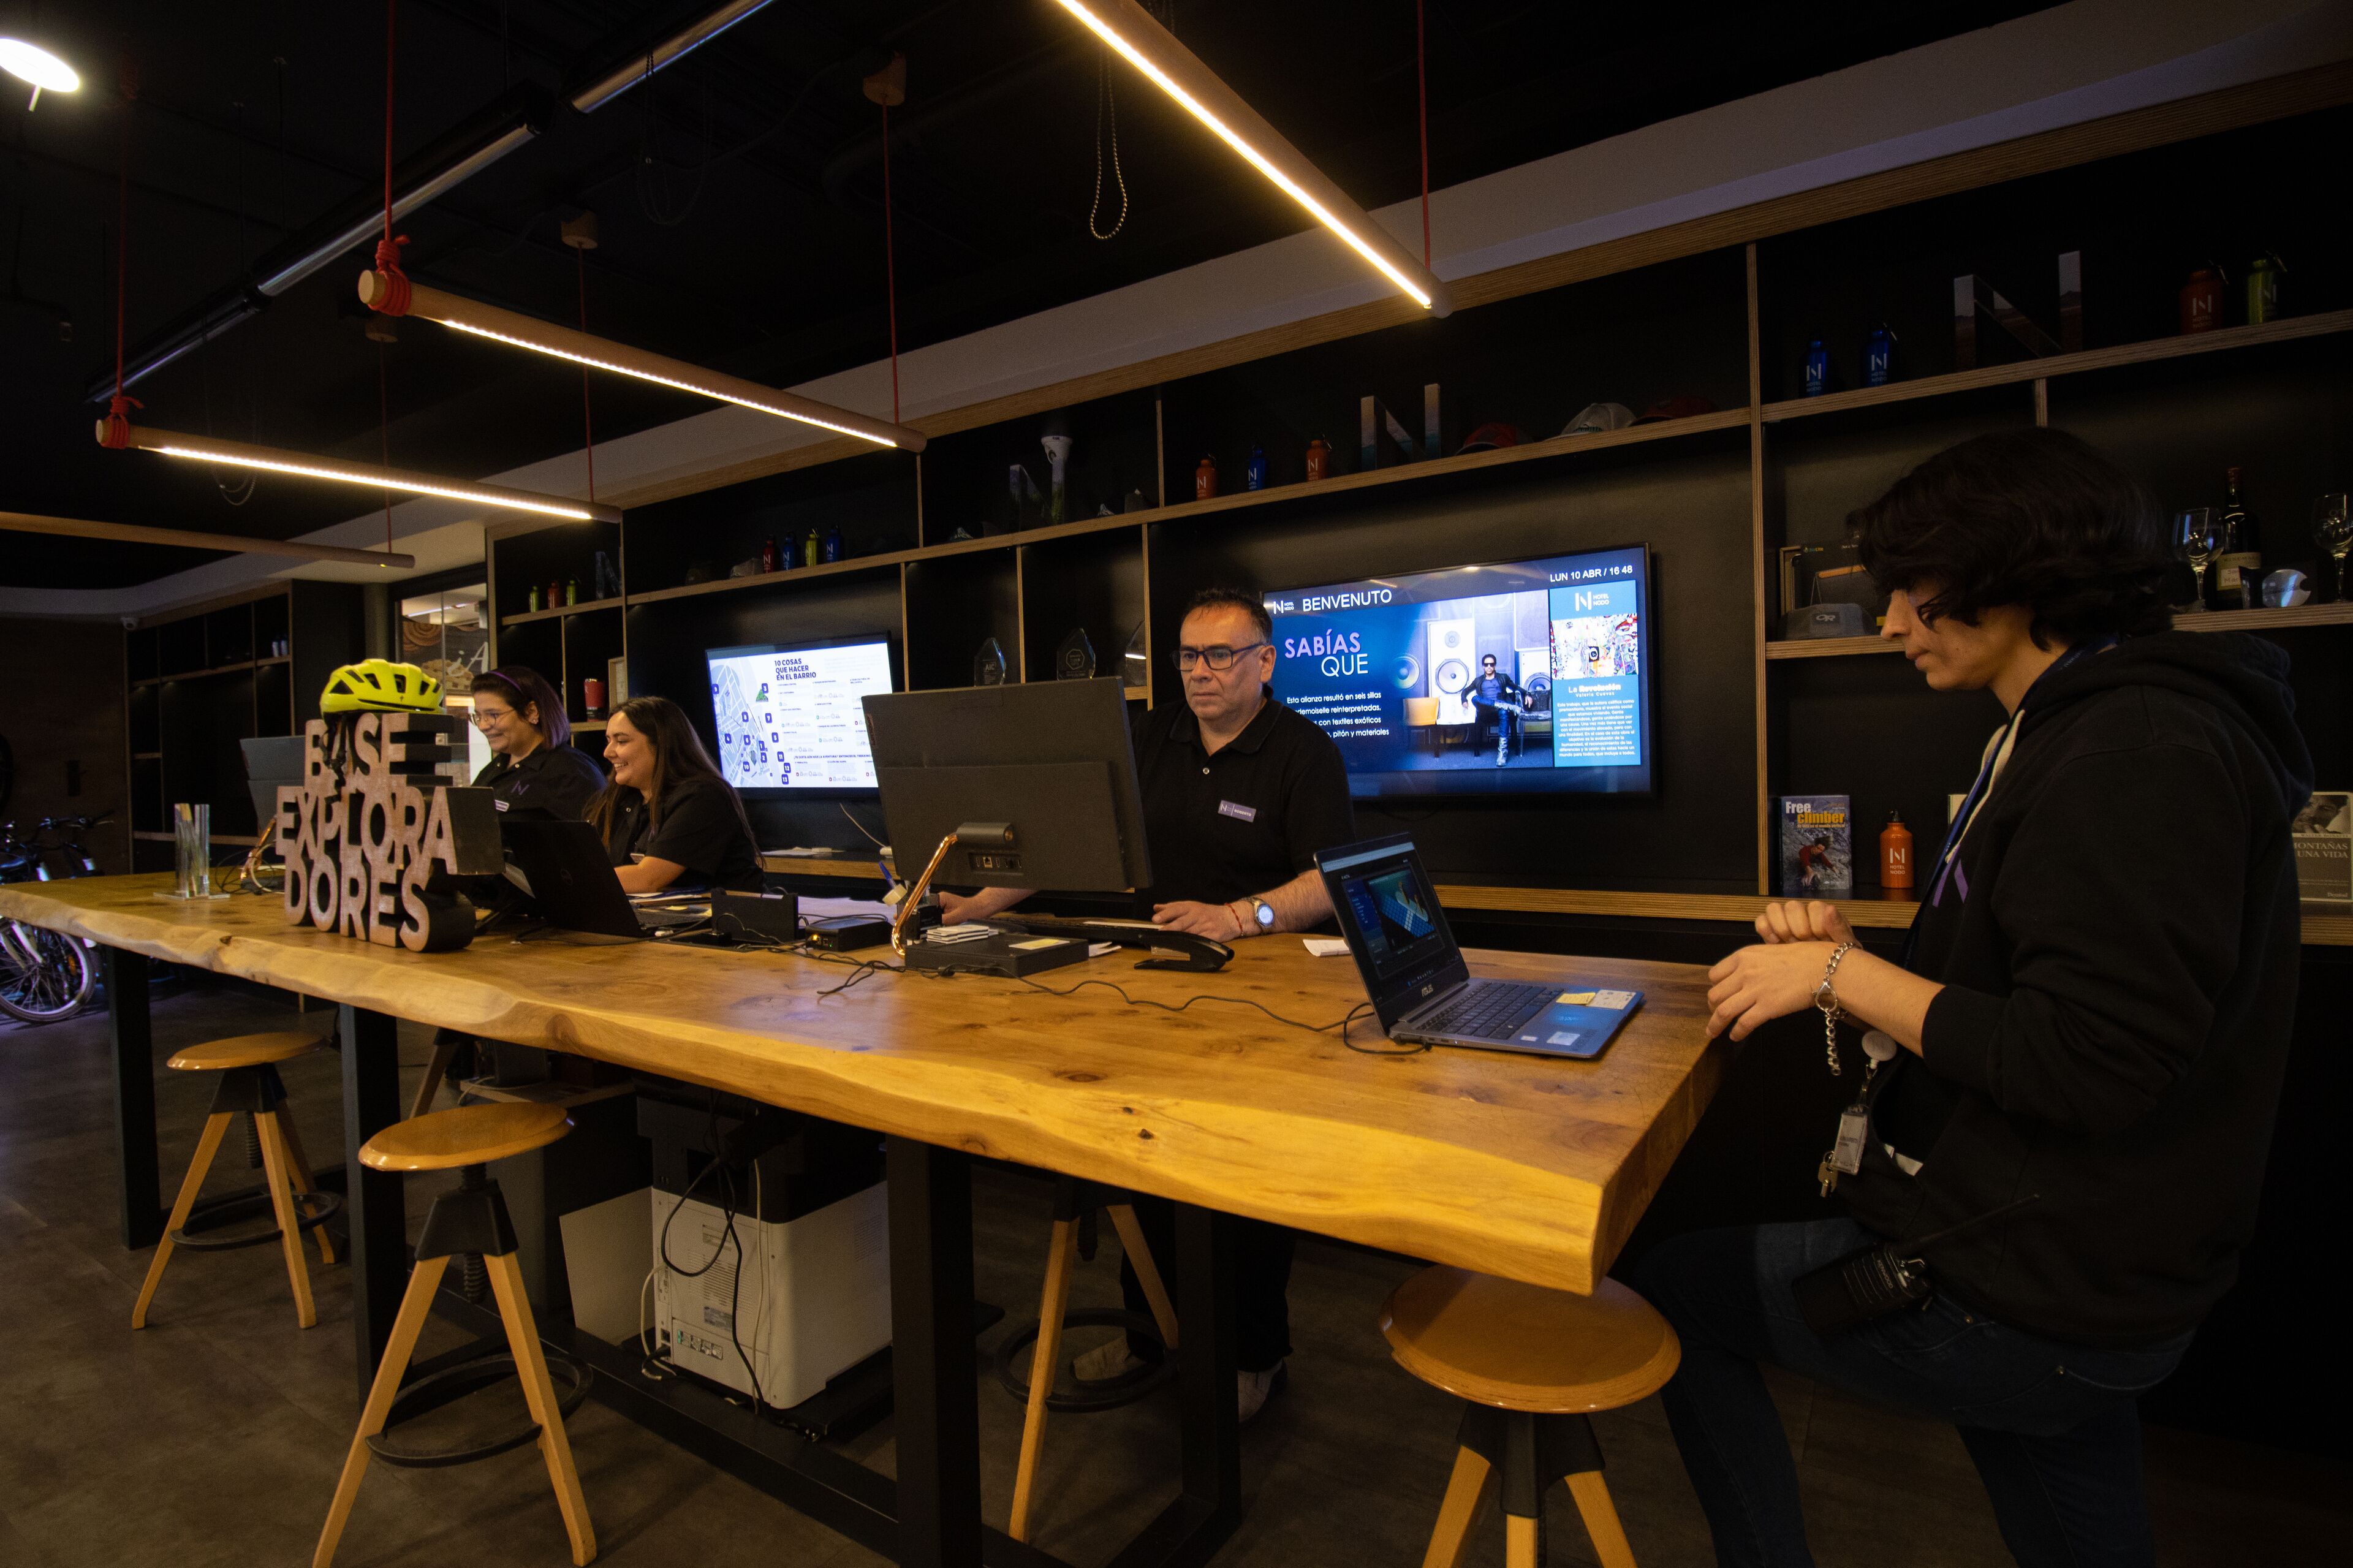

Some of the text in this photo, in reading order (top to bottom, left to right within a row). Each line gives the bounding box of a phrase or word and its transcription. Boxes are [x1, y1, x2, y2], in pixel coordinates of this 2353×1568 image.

[2193, 294, 2212, 316] N
[1871, 353, 1887, 371] N
[1806, 363, 1822, 381] N
[1308, 458, 1318, 472] N
[1248, 467, 1257, 481] N
[1550, 573, 1568, 582] LUN
[1571, 571, 1580, 580] 10
[1582, 569, 1602, 579] ABR
[1273, 600, 1284, 614] N
[1303, 589, 1392, 612] BENVENUTO
[1575, 591, 1592, 611] N
[1284, 629, 1361, 658] SABÍAS
[776, 667, 788, 675] QUE
[1321, 653, 1368, 677] QUE
[1579, 684, 1621, 692] Revolución
[1331, 705, 1381, 713] reinterpretadas,
[1333, 730, 1349, 738] pitón
[304, 712, 410, 798] BASE
[1786, 801, 1811, 814] Free
[1797, 811, 1845, 824] climber
[275, 786, 457, 876] EXPLORA
[1890, 848, 1905, 864] N
[284, 855, 430, 952] DORES
